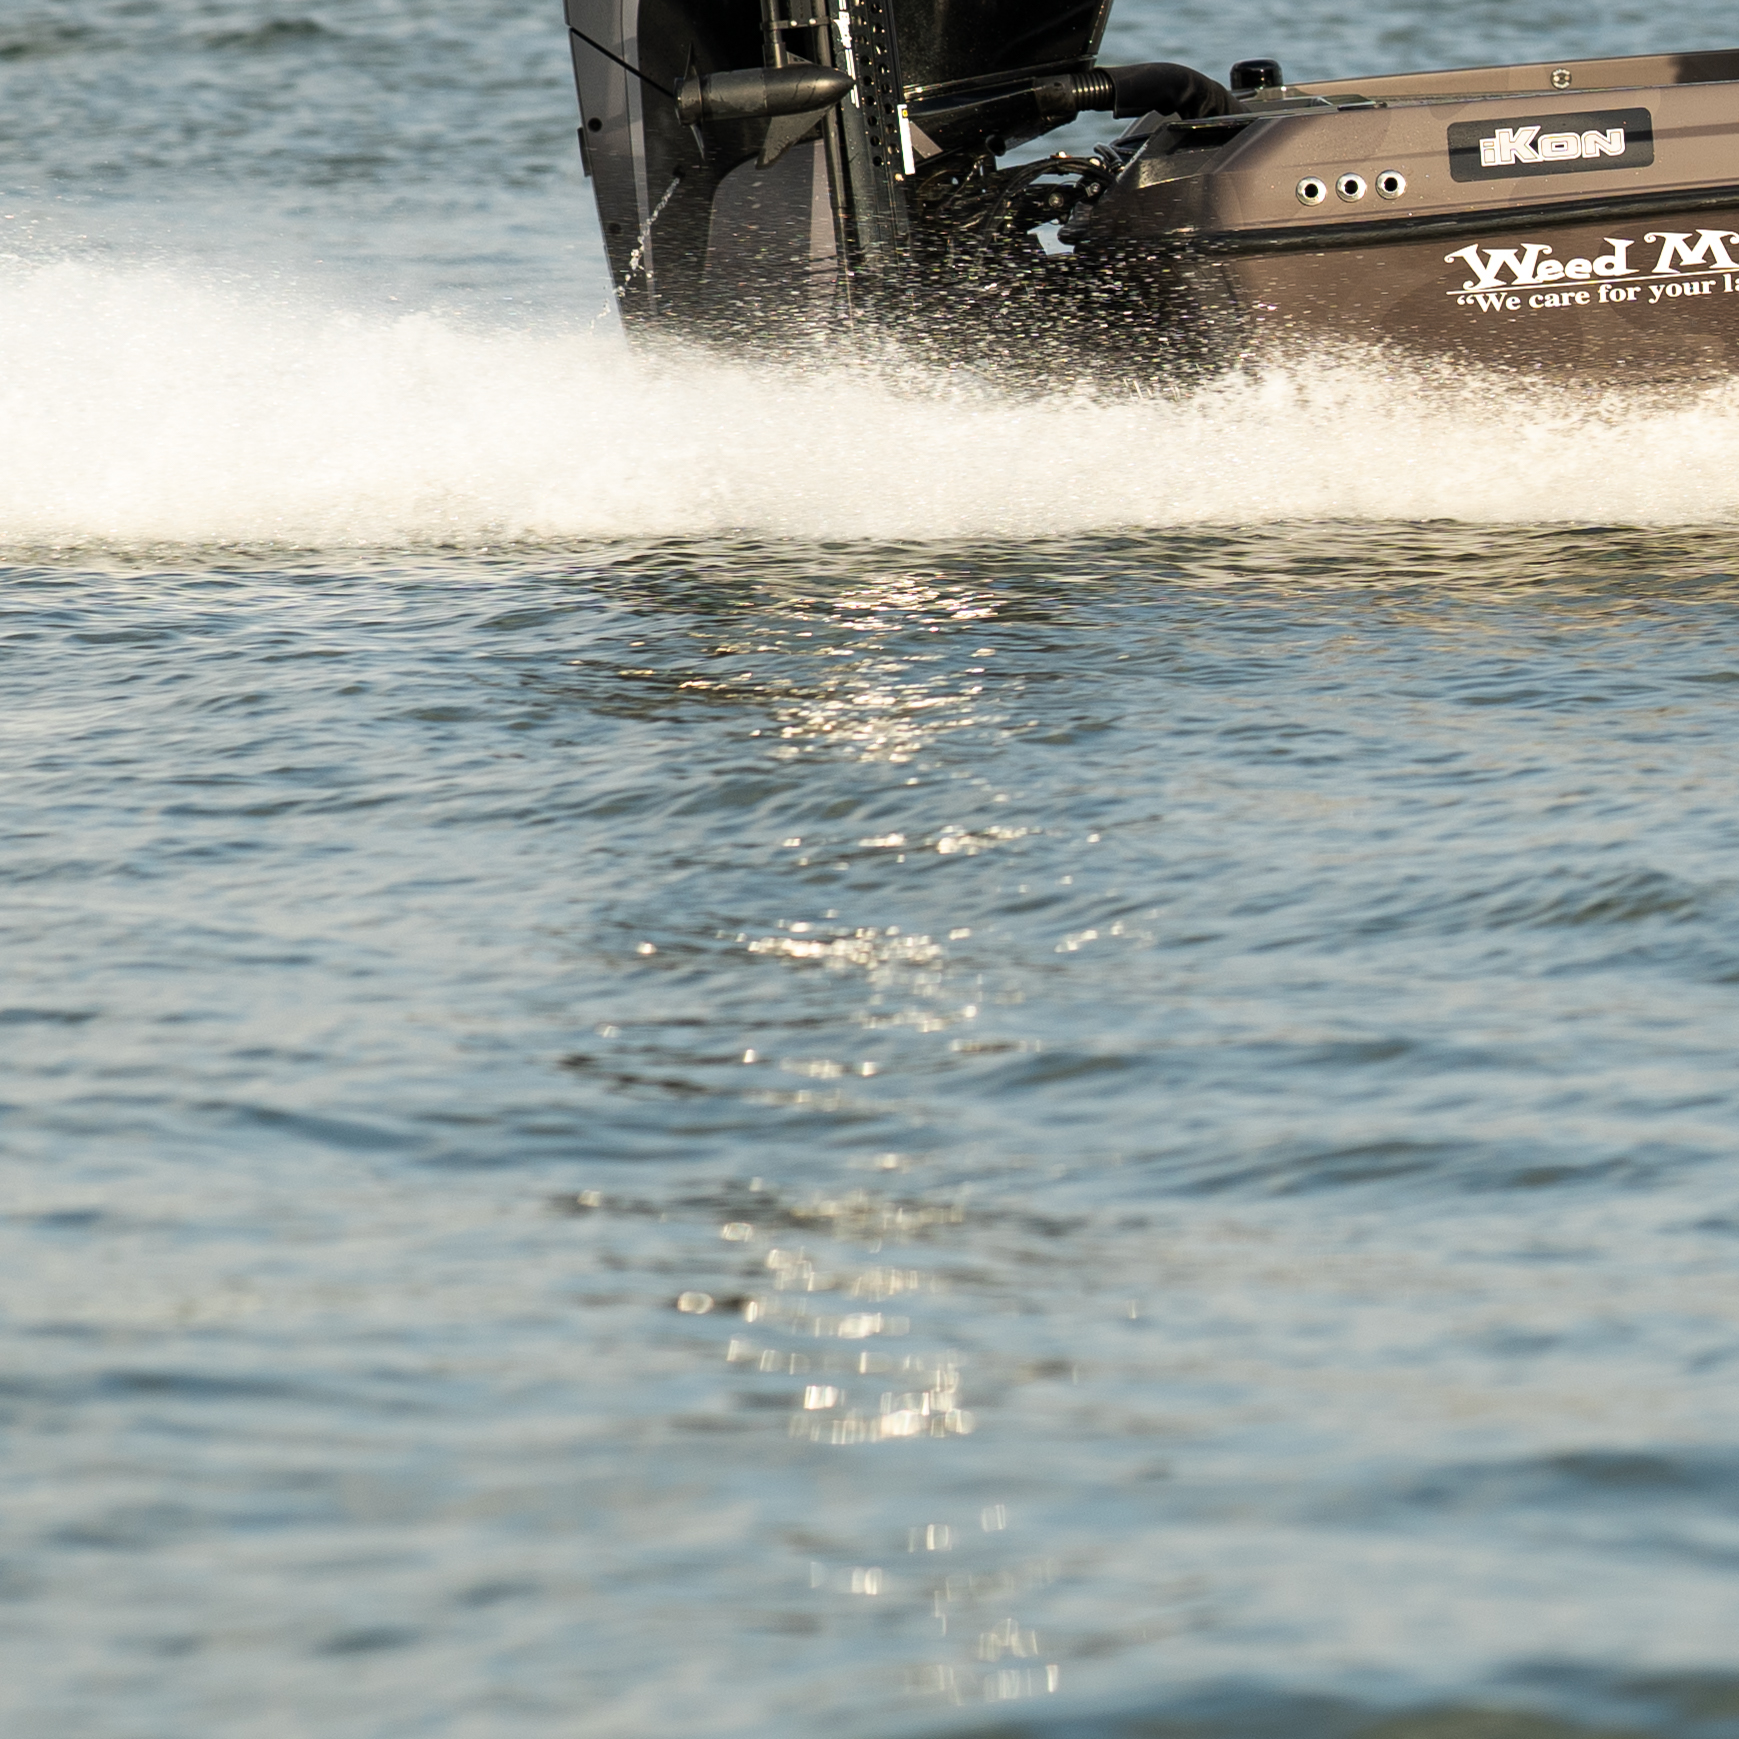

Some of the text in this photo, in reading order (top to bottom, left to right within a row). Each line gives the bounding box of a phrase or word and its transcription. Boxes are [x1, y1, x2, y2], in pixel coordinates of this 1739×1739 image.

[1444, 236, 1640, 291] Weed
[1528, 288, 1591, 310] care
[1597, 283, 1642, 303] for
[1648, 278, 1717, 303] your
